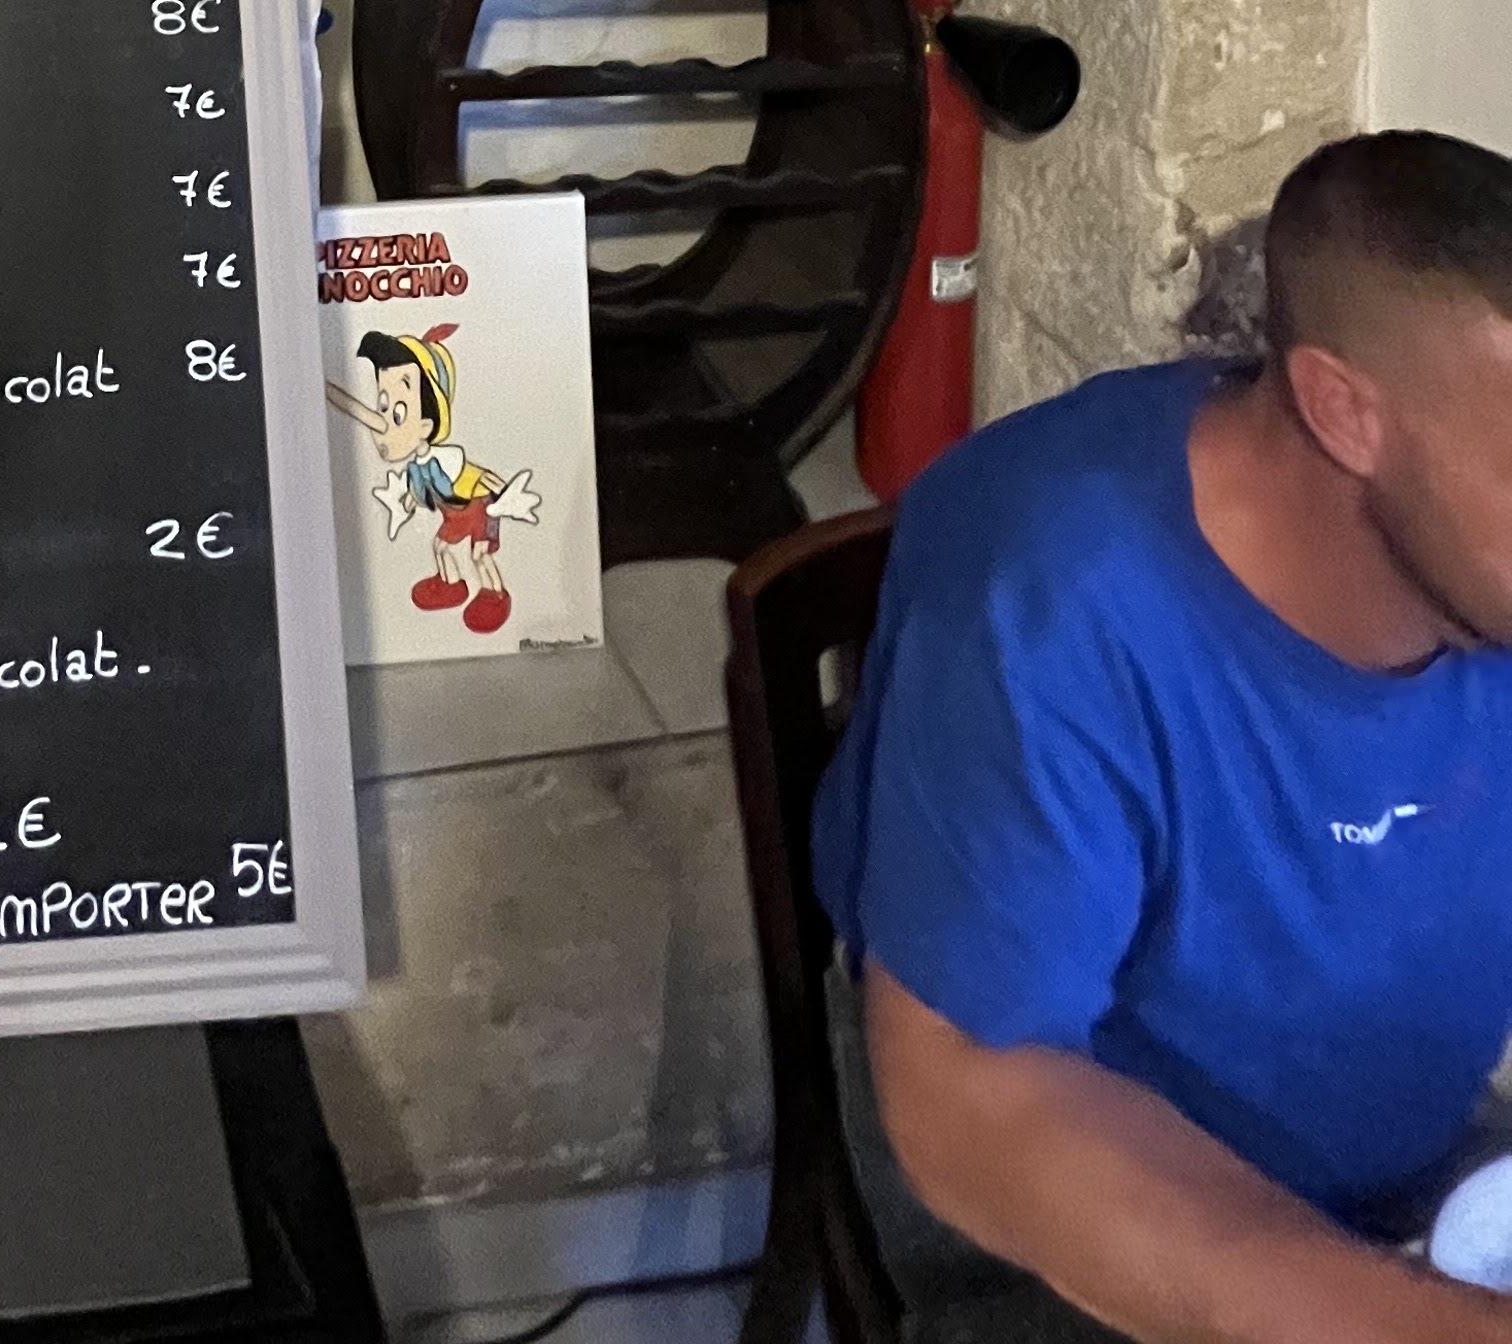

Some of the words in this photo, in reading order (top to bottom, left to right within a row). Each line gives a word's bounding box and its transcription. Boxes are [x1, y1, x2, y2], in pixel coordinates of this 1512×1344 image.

[164, 83, 226, 119] 7€
[171, 170, 233, 208] 7€
[182, 252, 242, 289] 7€
[184, 338, 248, 382] 8€
[144, 511, 236, 561] 2€
[230, 838, 293, 898] 5€
